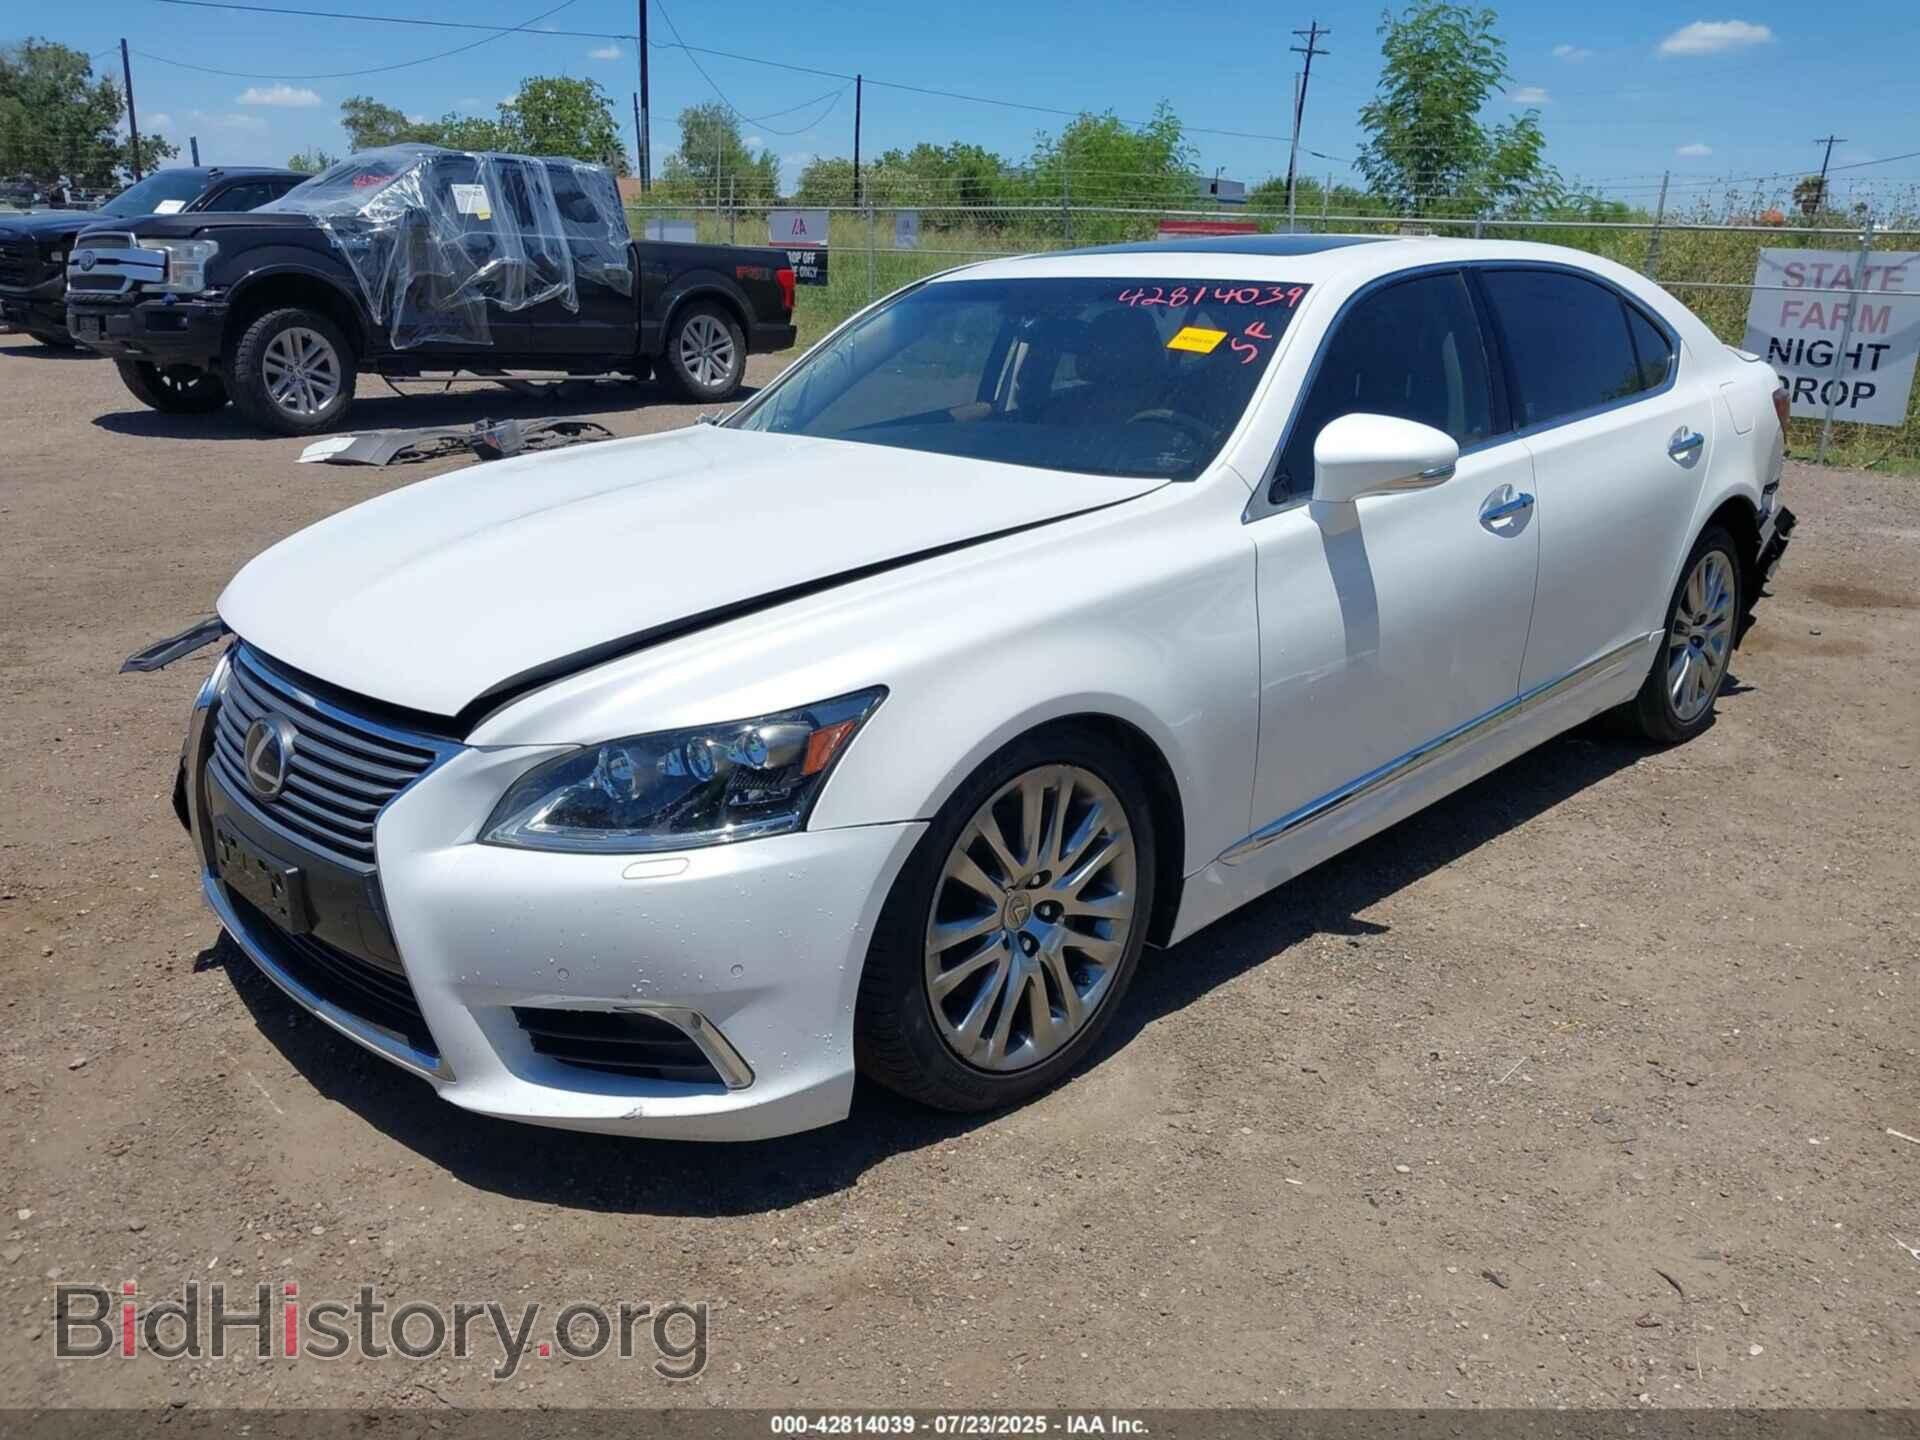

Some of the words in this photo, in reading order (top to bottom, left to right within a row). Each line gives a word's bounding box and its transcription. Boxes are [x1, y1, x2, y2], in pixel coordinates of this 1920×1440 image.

[1782, 262, 1908, 291] STATE
[1118, 286, 1304, 308] 42814039
[1780, 301, 1891, 334] FARM
[1768, 337, 1890, 371] NIGHT
